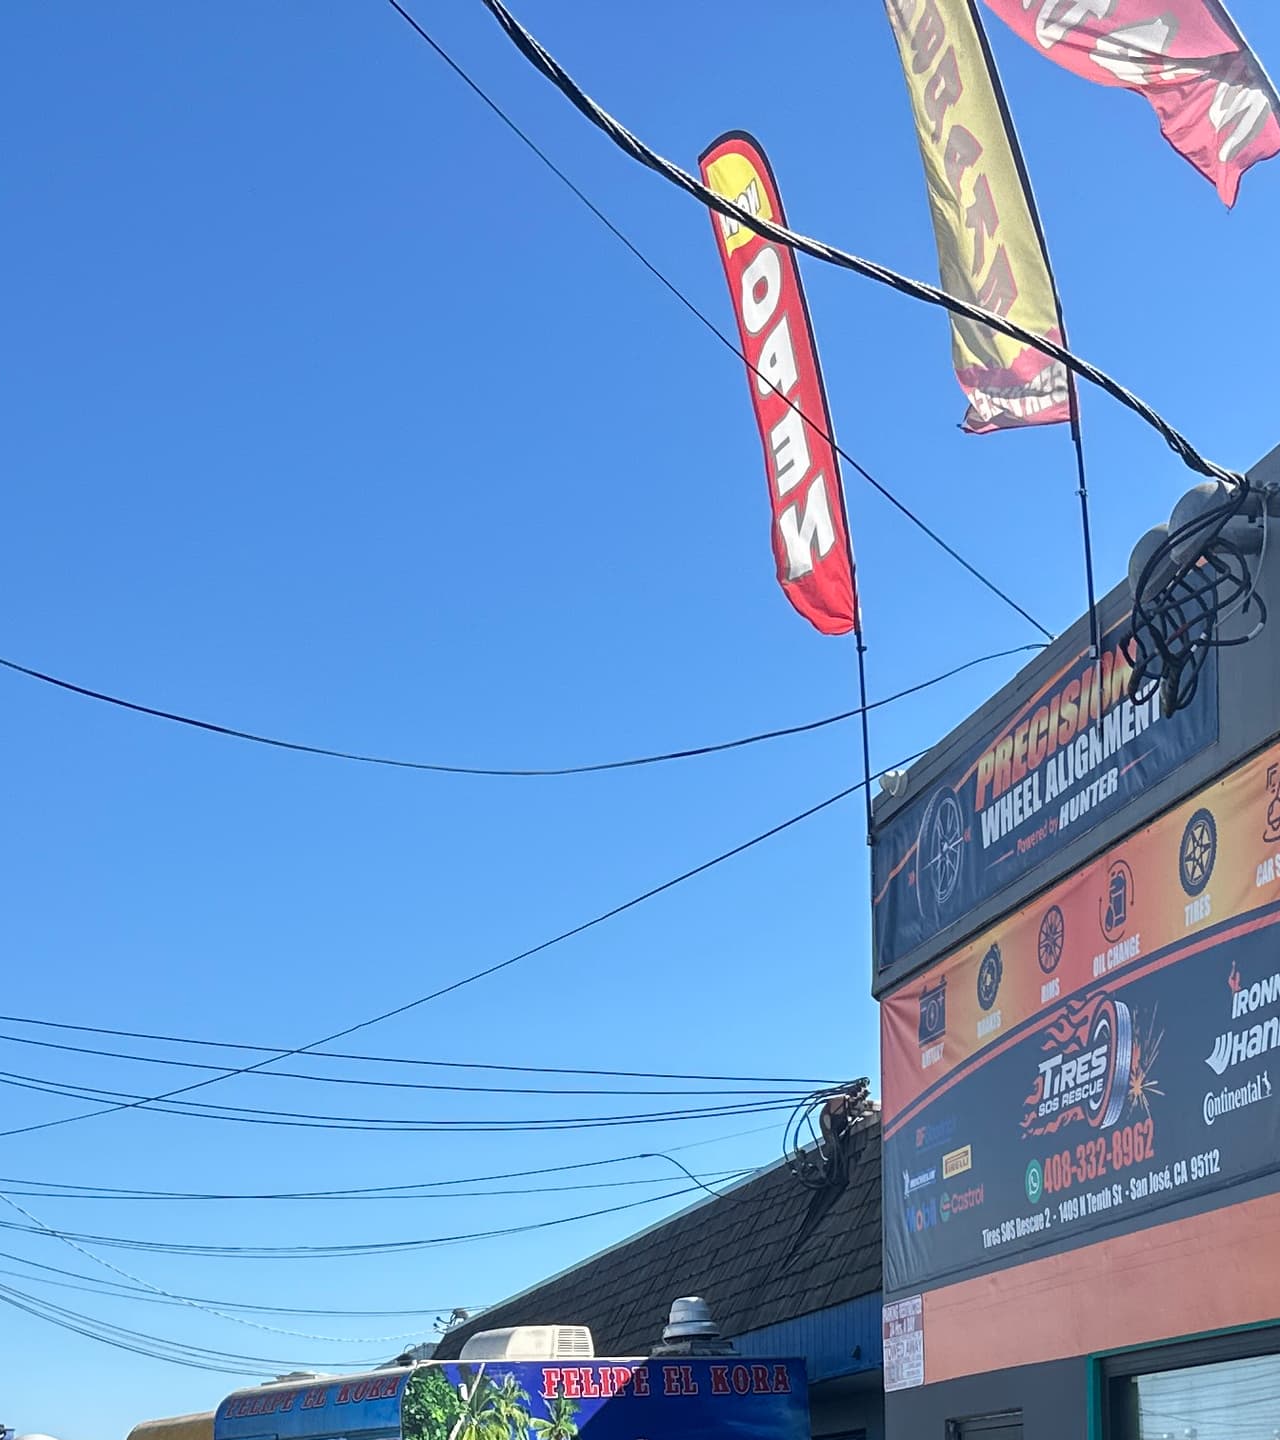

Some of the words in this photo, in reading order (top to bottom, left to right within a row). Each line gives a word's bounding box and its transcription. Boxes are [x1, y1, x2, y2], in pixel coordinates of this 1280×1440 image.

[975, 636, 1137, 812] PRECISION
[981, 771, 1042, 849] WHEEL
[1045, 679, 1161, 804] ALIGNMENT
[1017, 826, 1048, 856] Powered
[1059, 767, 1118, 830] HUNTER
[1256, 857, 1275, 887] CAR
[1185, 894, 1211, 927] TIRES
[1093, 953, 1106, 977] OIL
[1107, 933, 1140, 970] CHANGE
[1038, 1097, 1059, 1117] SOS
[1061, 1078, 1103, 1108] RESCUE
[1204, 1075, 1261, 1126] Continental
[1043, 1119, 1155, 1193] 408-332-8962
[982, 1227, 1000, 1249] Tires
[1001, 1218, 1016, 1242] SOS
[1016, 1211, 1045, 1237] Rescue
[1045, 1208, 1051, 1228] 2
[1087, 1186, 1111, 1214] Tenth
[1112, 1184, 1122, 1206] St
[1130, 1177, 1148, 1201] San
[1173, 1160, 1187, 1186] CA
[1190, 1148, 1221, 1179] 95112
[224, 1391, 299, 1419] FELIPE
[301, 1389, 327, 1410] EL
[335, 1375, 402, 1405] KORA
[542, 1366, 650, 1398] FELIPE
[663, 1366, 698, 1396] EL
[710, 1364, 791, 1395] KORA
